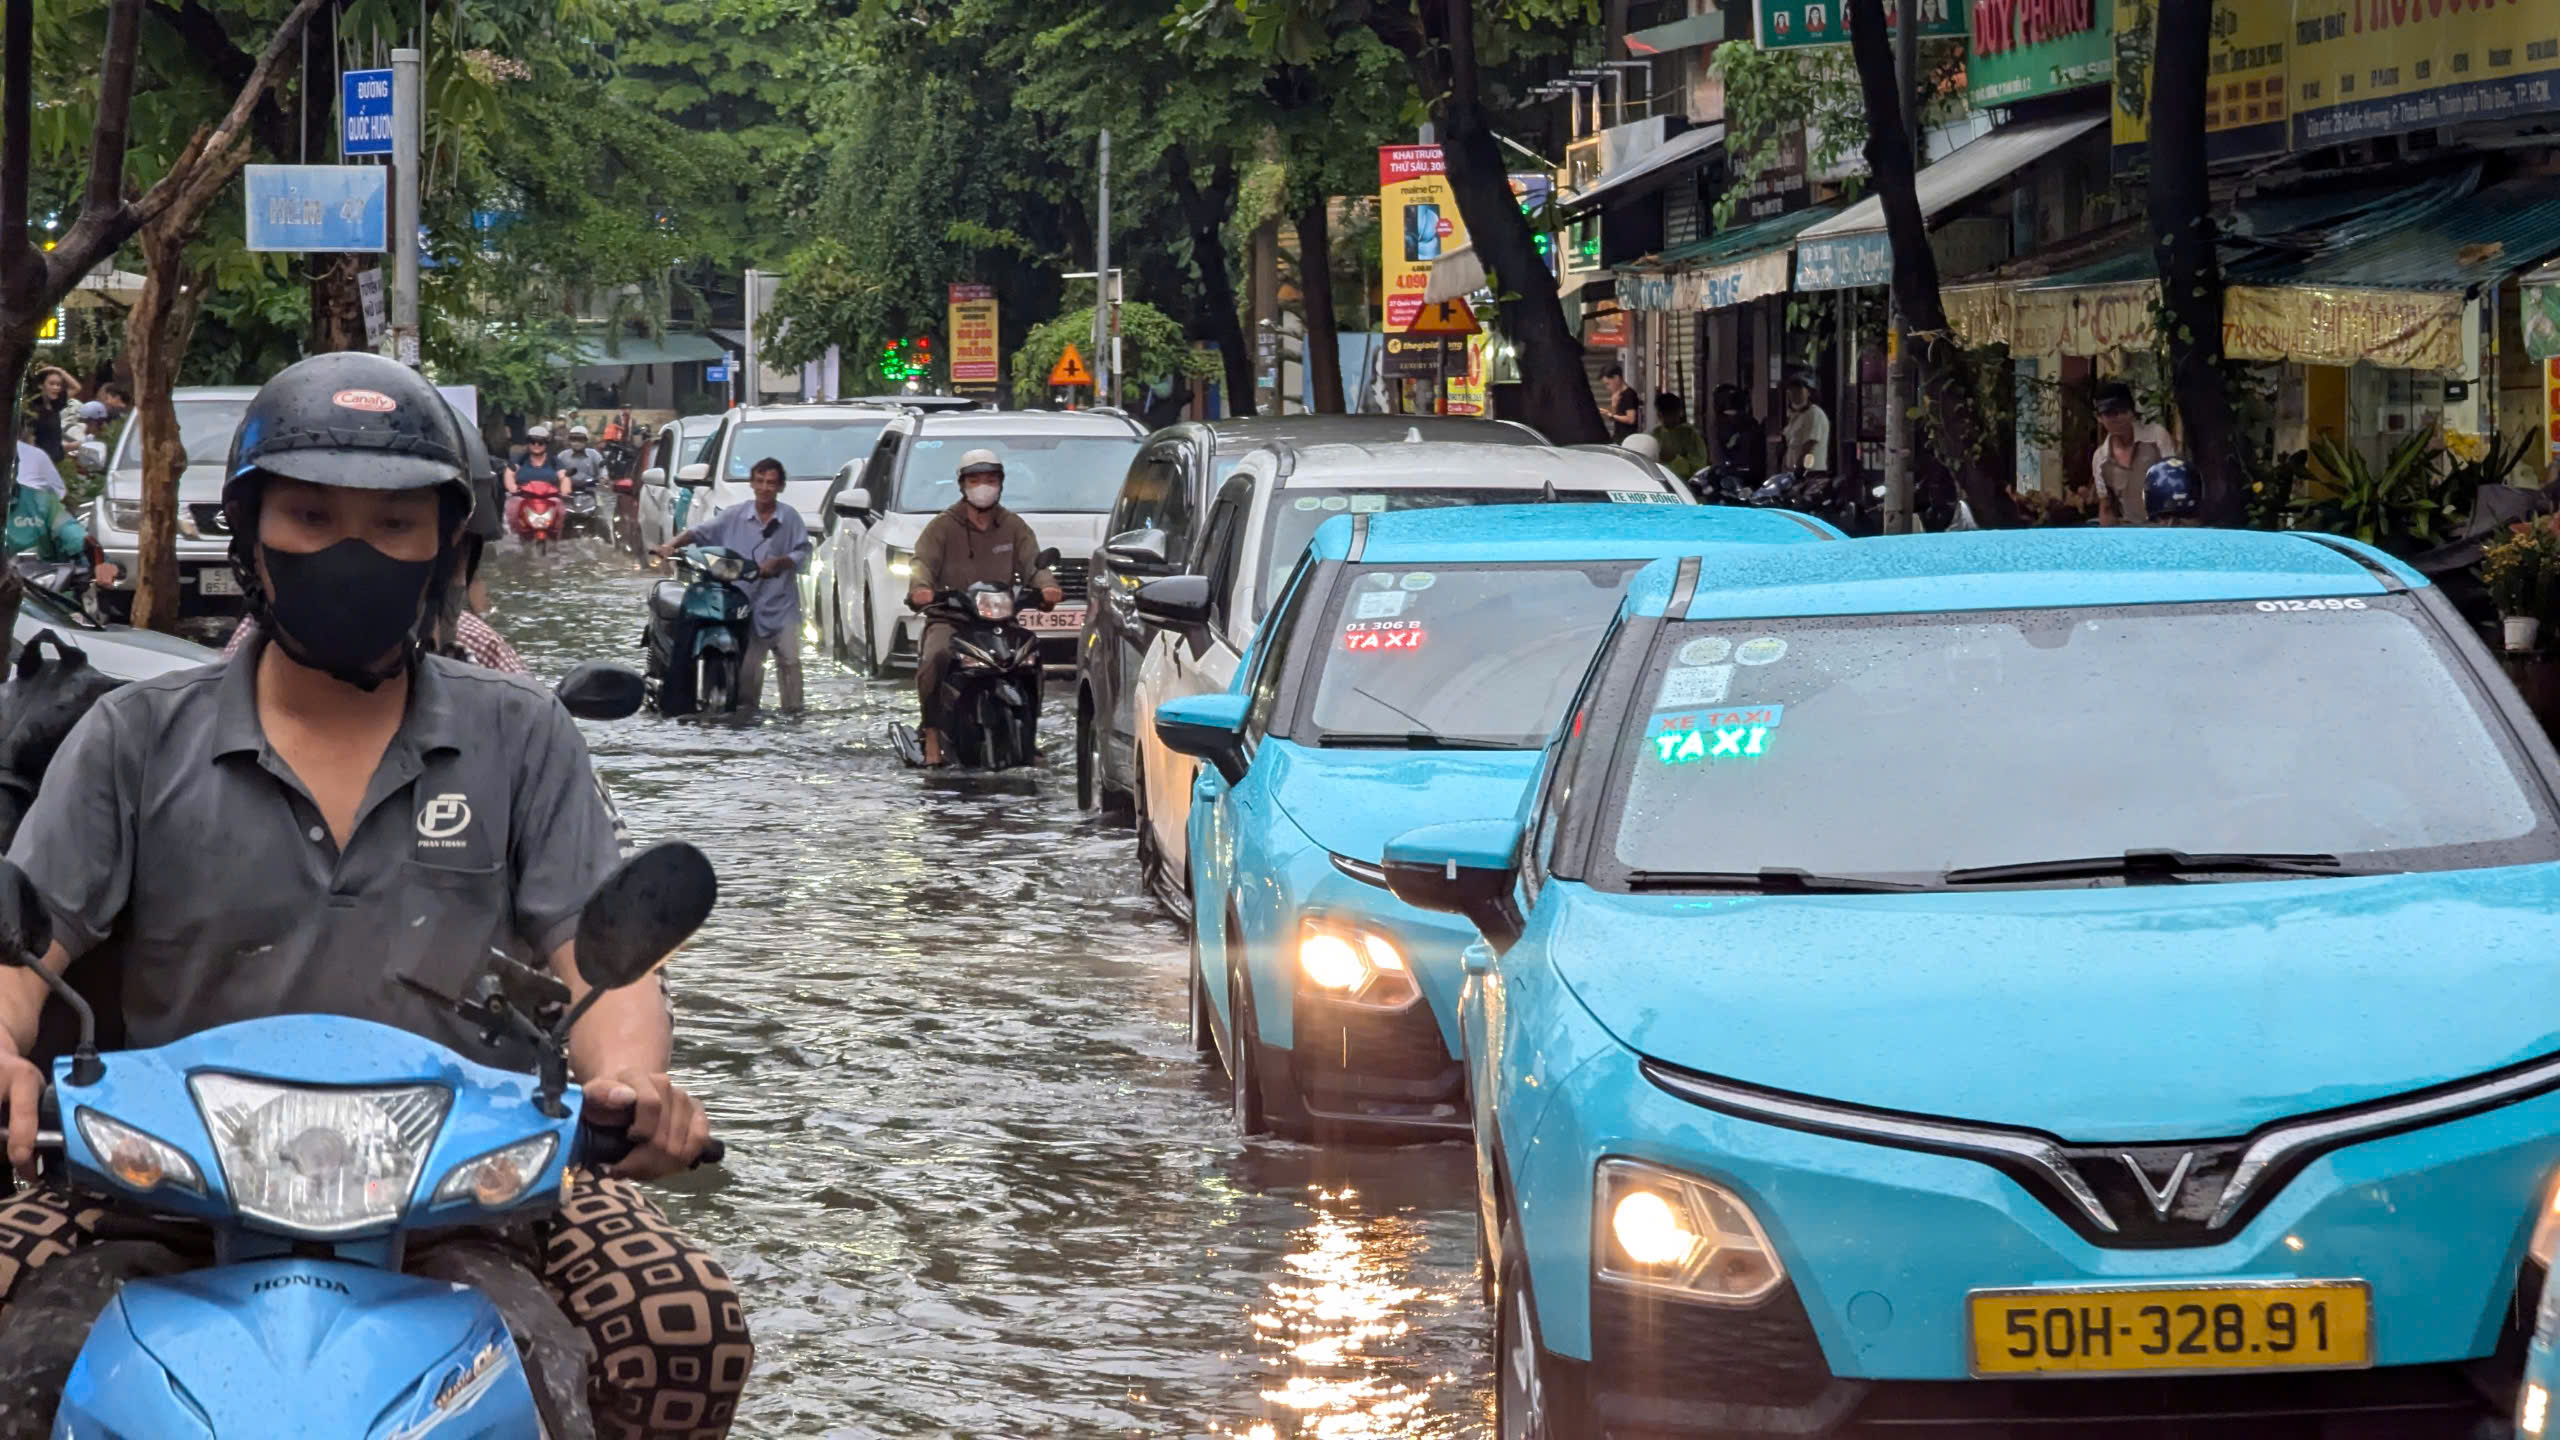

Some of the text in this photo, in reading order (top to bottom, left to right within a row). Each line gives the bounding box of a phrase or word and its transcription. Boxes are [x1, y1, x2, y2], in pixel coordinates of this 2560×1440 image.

[358, 76, 388, 99] ĐƯỜNG
[348, 105, 370, 141] QUỐC
[1393, 151, 1414, 160] KHAI
[1390, 162, 1408, 172] THỨ
[1611, 492, 1626, 502] XE
[1345, 620, 1421, 631] 01 306 B
[1347, 632, 1420, 648] TAXI
[1661, 710, 1772, 730] XE TAXI
[1656, 727, 1767, 760] TAXI
[253, 1275, 350, 1295] HONDA
[2006, 1301, 2329, 1358] 50H-328.91
